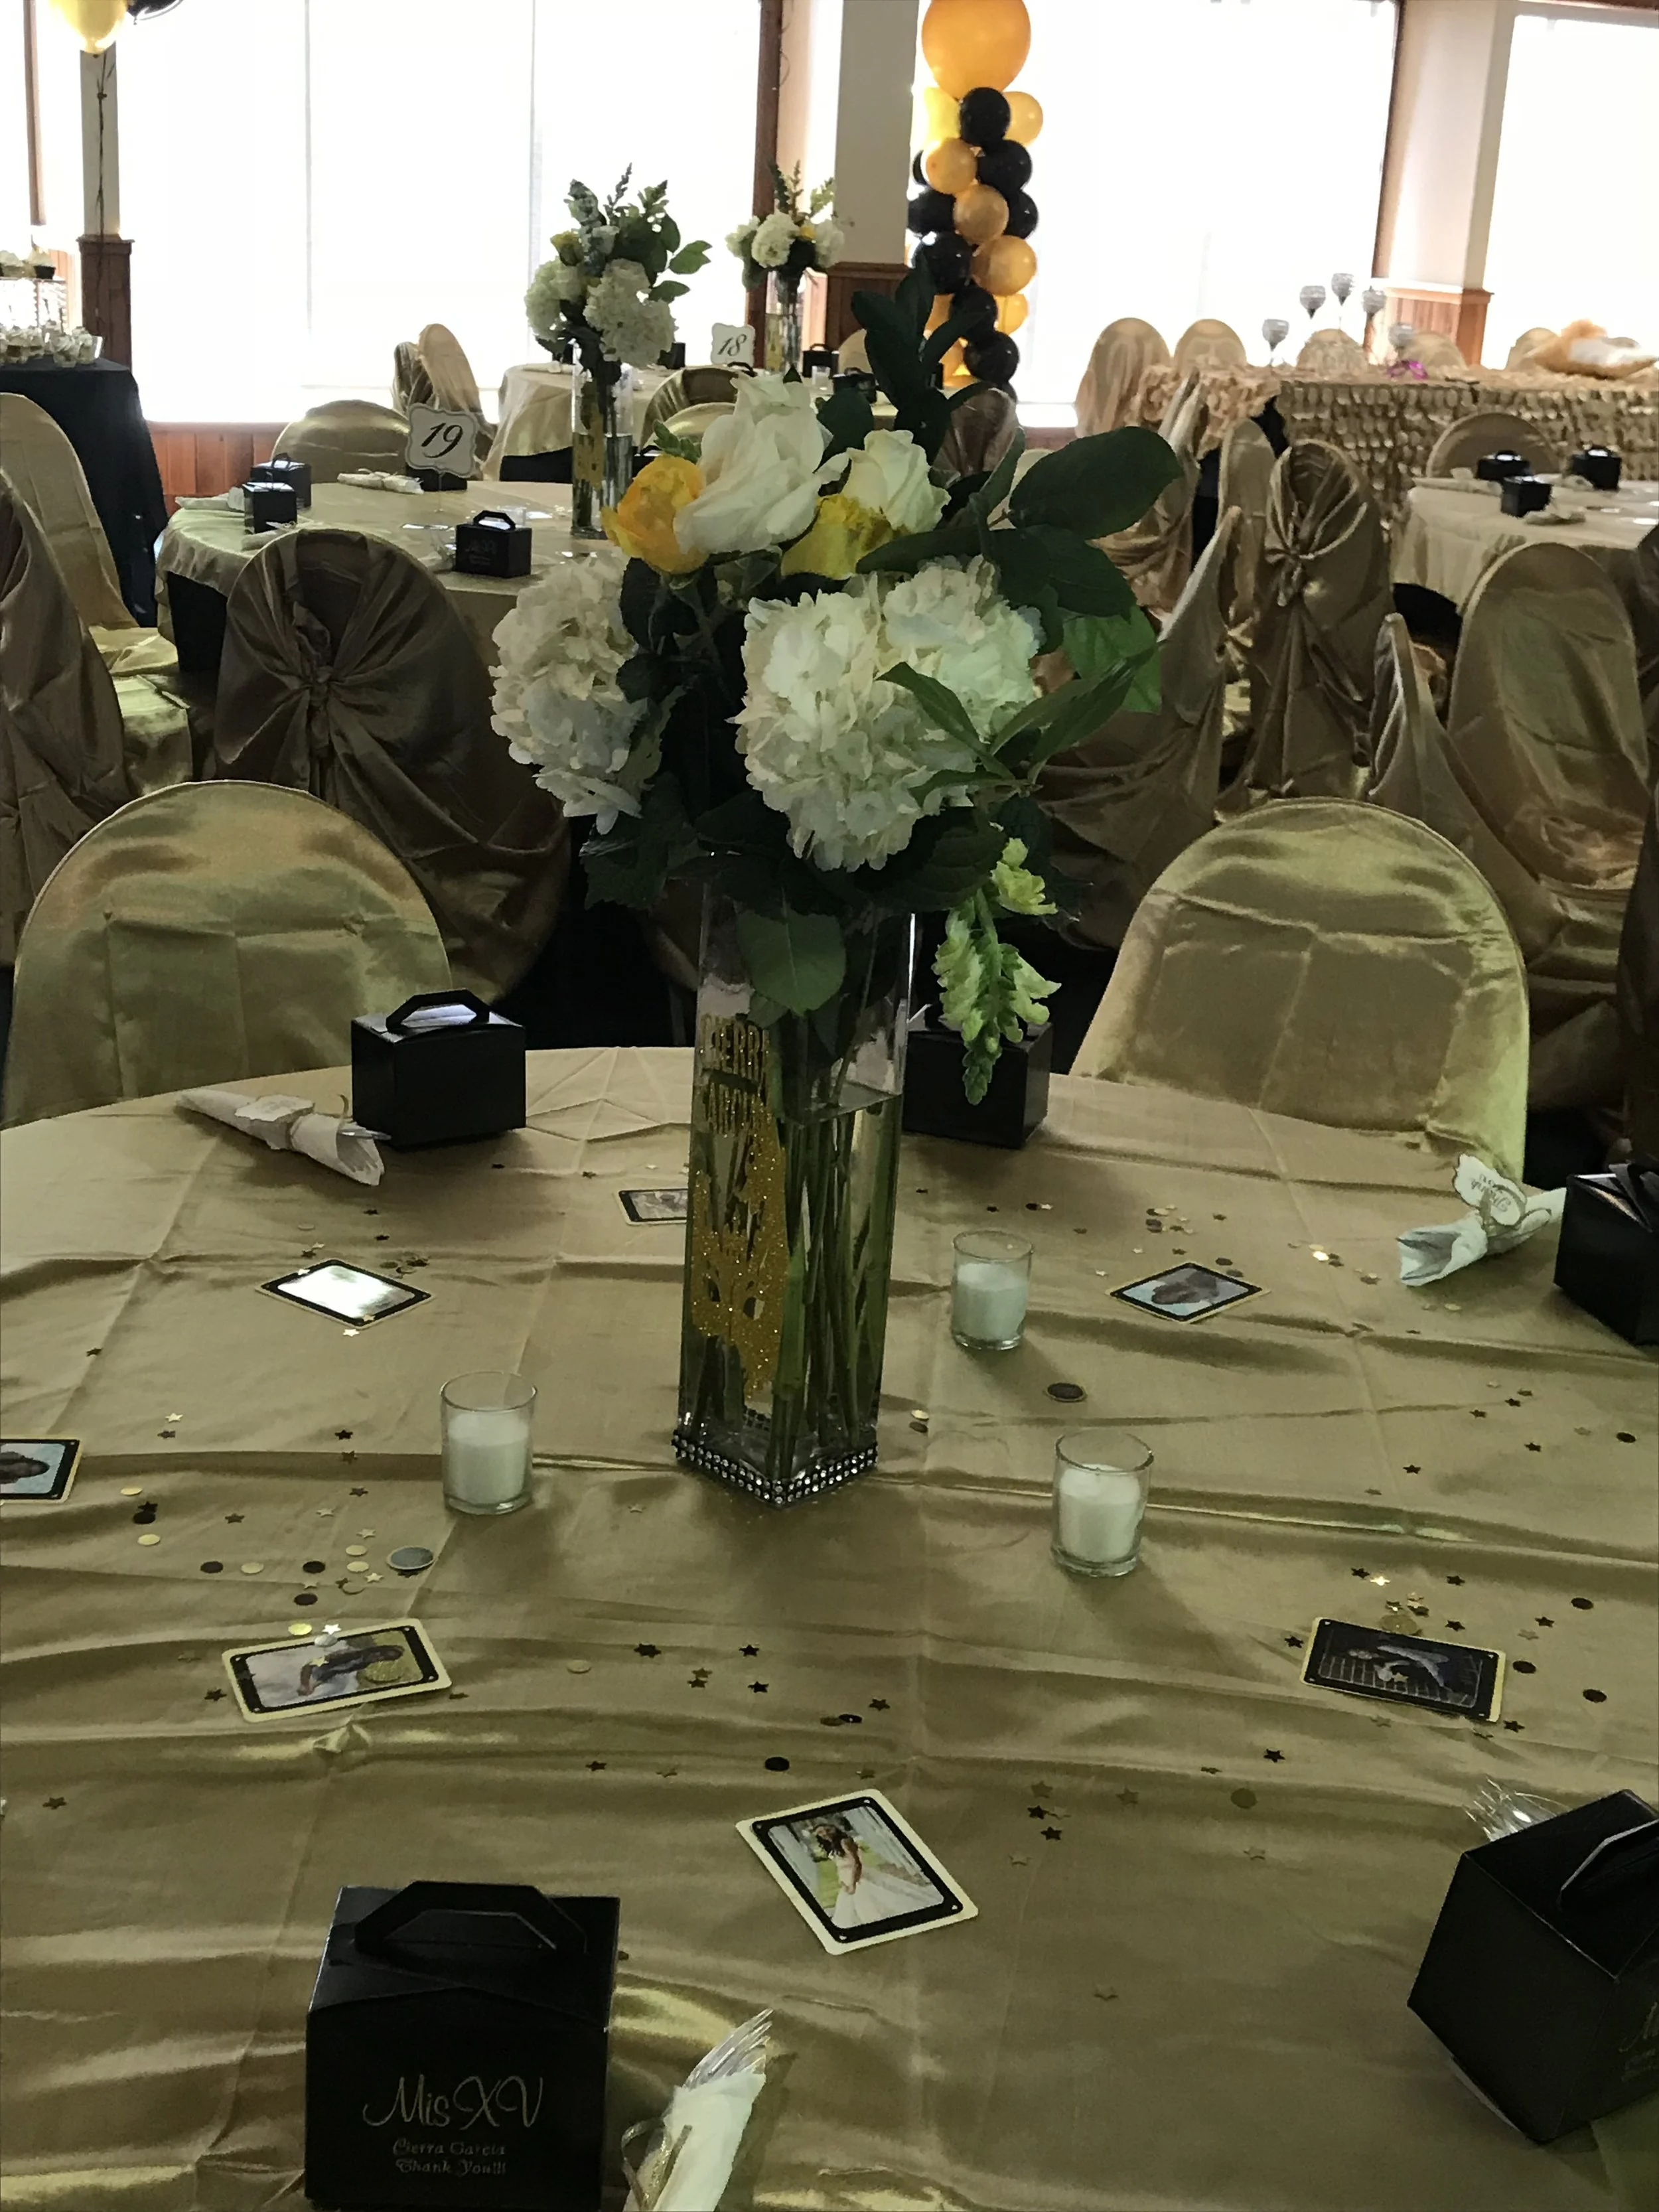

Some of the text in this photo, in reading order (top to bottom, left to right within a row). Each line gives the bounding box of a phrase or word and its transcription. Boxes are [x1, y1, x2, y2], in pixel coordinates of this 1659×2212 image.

[717, 334, 747, 356] 18
[421, 423, 464, 458] 19
[362, 2074, 544, 2130] Mis XV
[450, 2141, 506, 2156] Garcia
[396, 2158, 452, 2174] Thank
